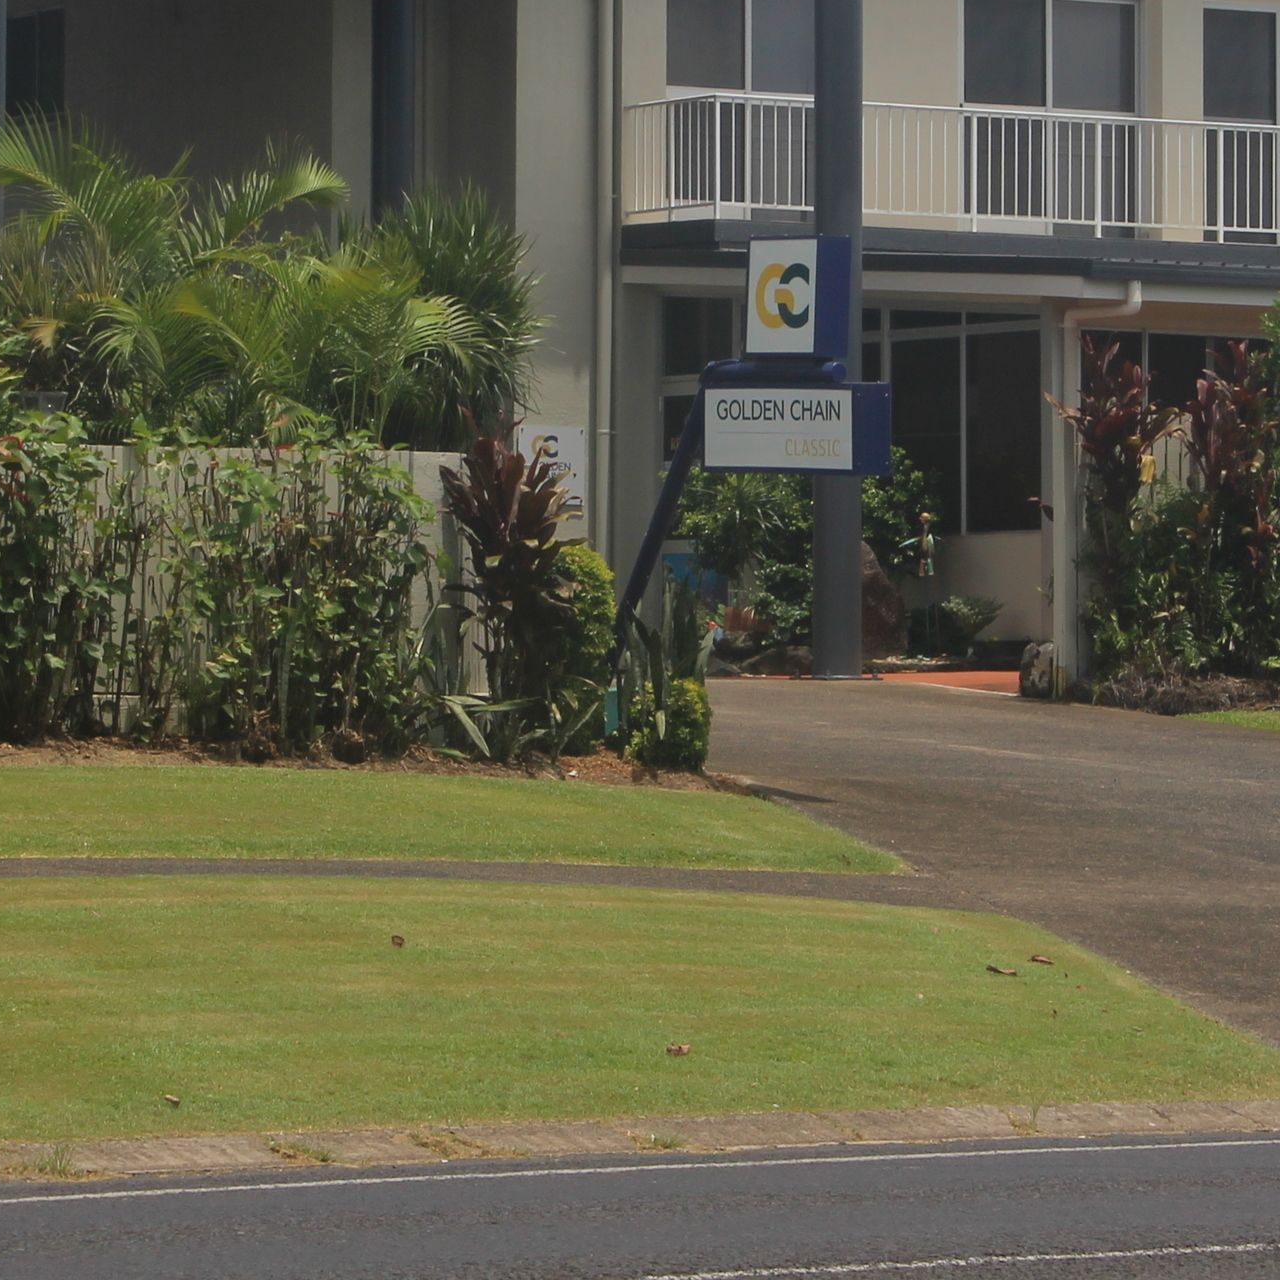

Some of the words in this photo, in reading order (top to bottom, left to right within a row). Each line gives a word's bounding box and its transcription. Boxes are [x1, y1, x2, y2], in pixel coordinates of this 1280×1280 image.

[716, 399, 785, 421] GOLDEN
[789, 399, 842, 421] CHAIN
[784, 438, 841, 457] CLASSIC
